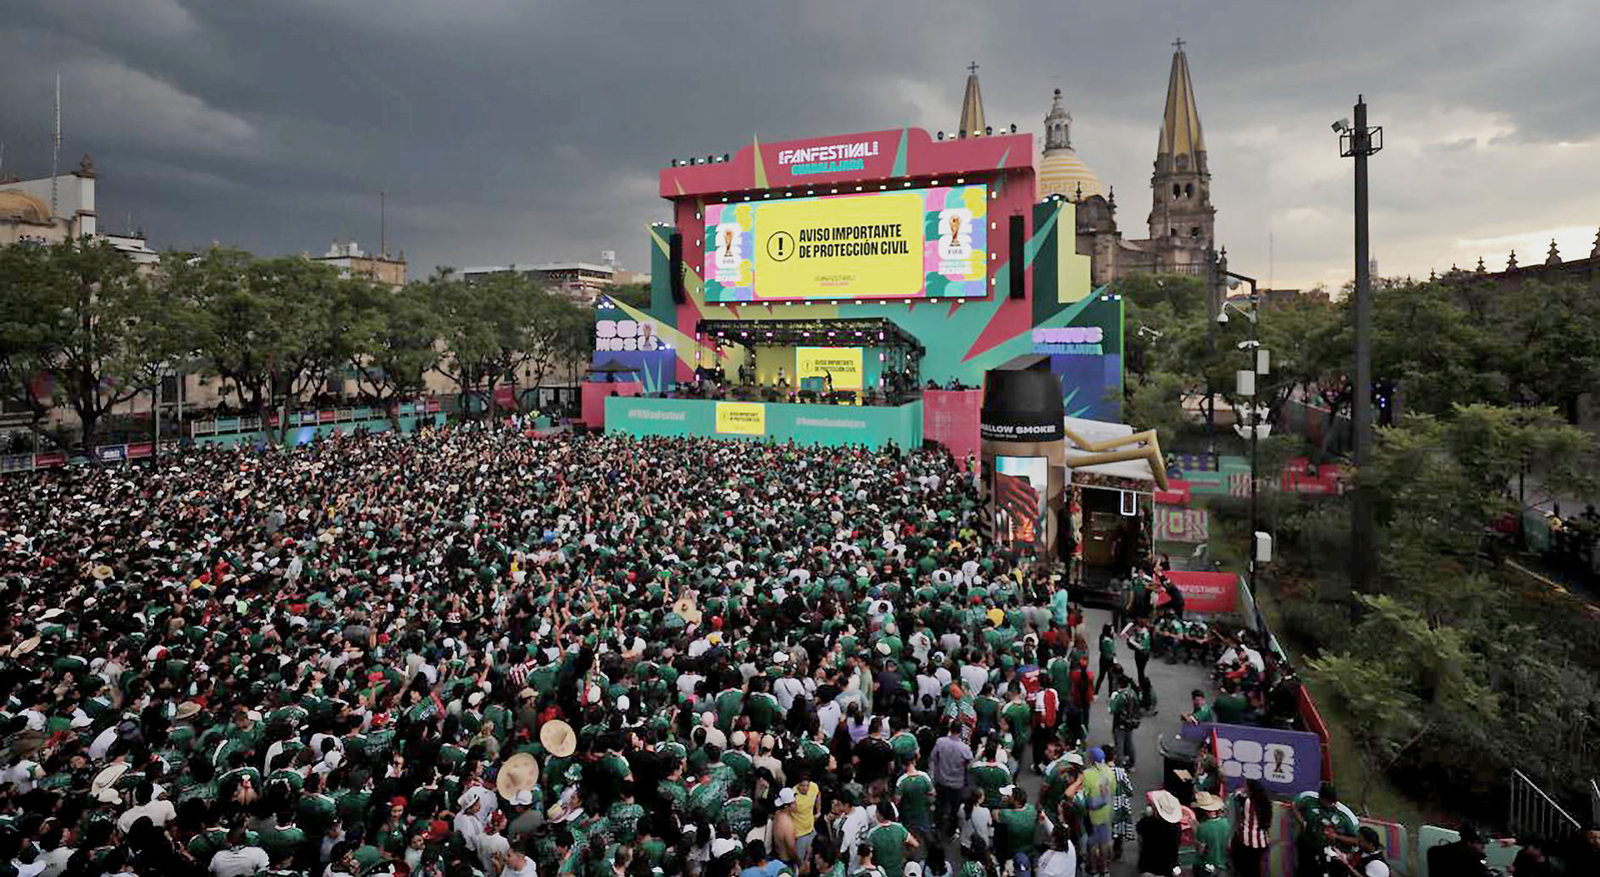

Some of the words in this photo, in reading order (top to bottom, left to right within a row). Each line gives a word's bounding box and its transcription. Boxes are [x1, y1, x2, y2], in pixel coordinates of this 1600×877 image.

[799, 228, 830, 242] AVISO
[832, 224, 902, 241] IMPORTANTE
[799, 245, 811, 258] DE
[813, 240, 878, 258] PROTECCIÓN
[880, 241, 909, 255] CIVIL
